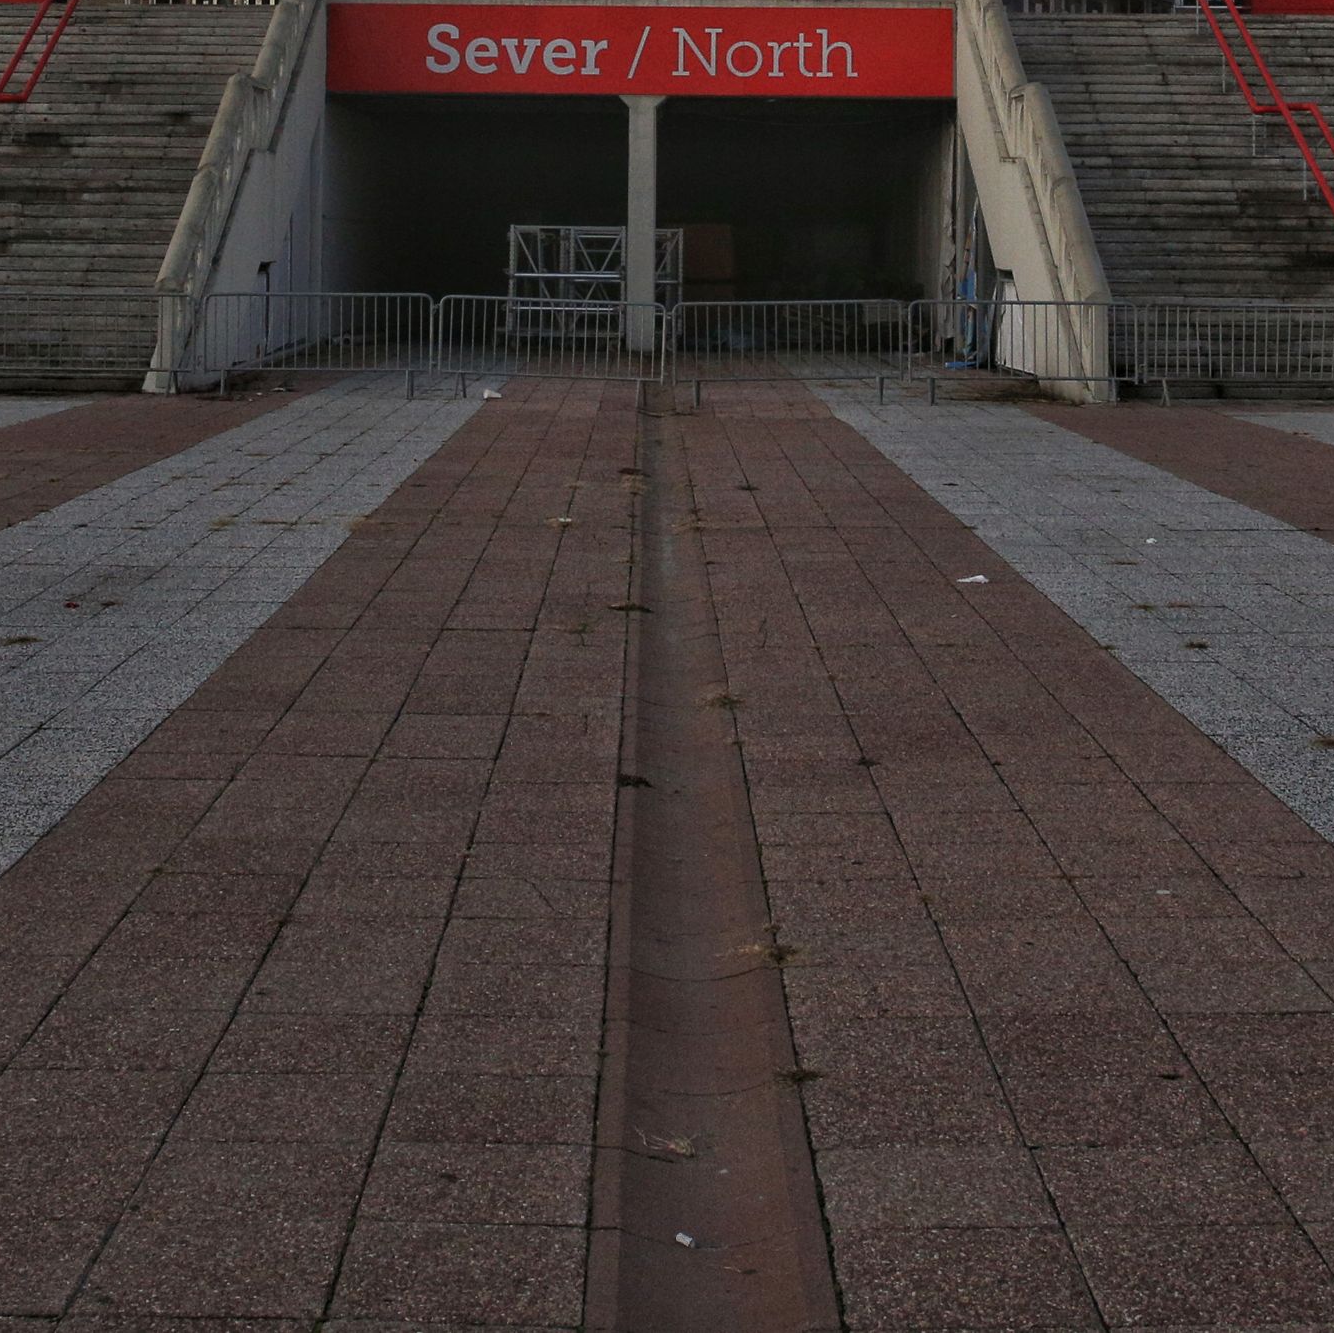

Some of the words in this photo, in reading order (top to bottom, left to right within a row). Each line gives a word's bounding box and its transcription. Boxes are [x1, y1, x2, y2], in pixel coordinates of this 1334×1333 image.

[425, 22, 608, 76] Sever
[627, 25, 651, 80] /
[671, 26, 858, 79] North
